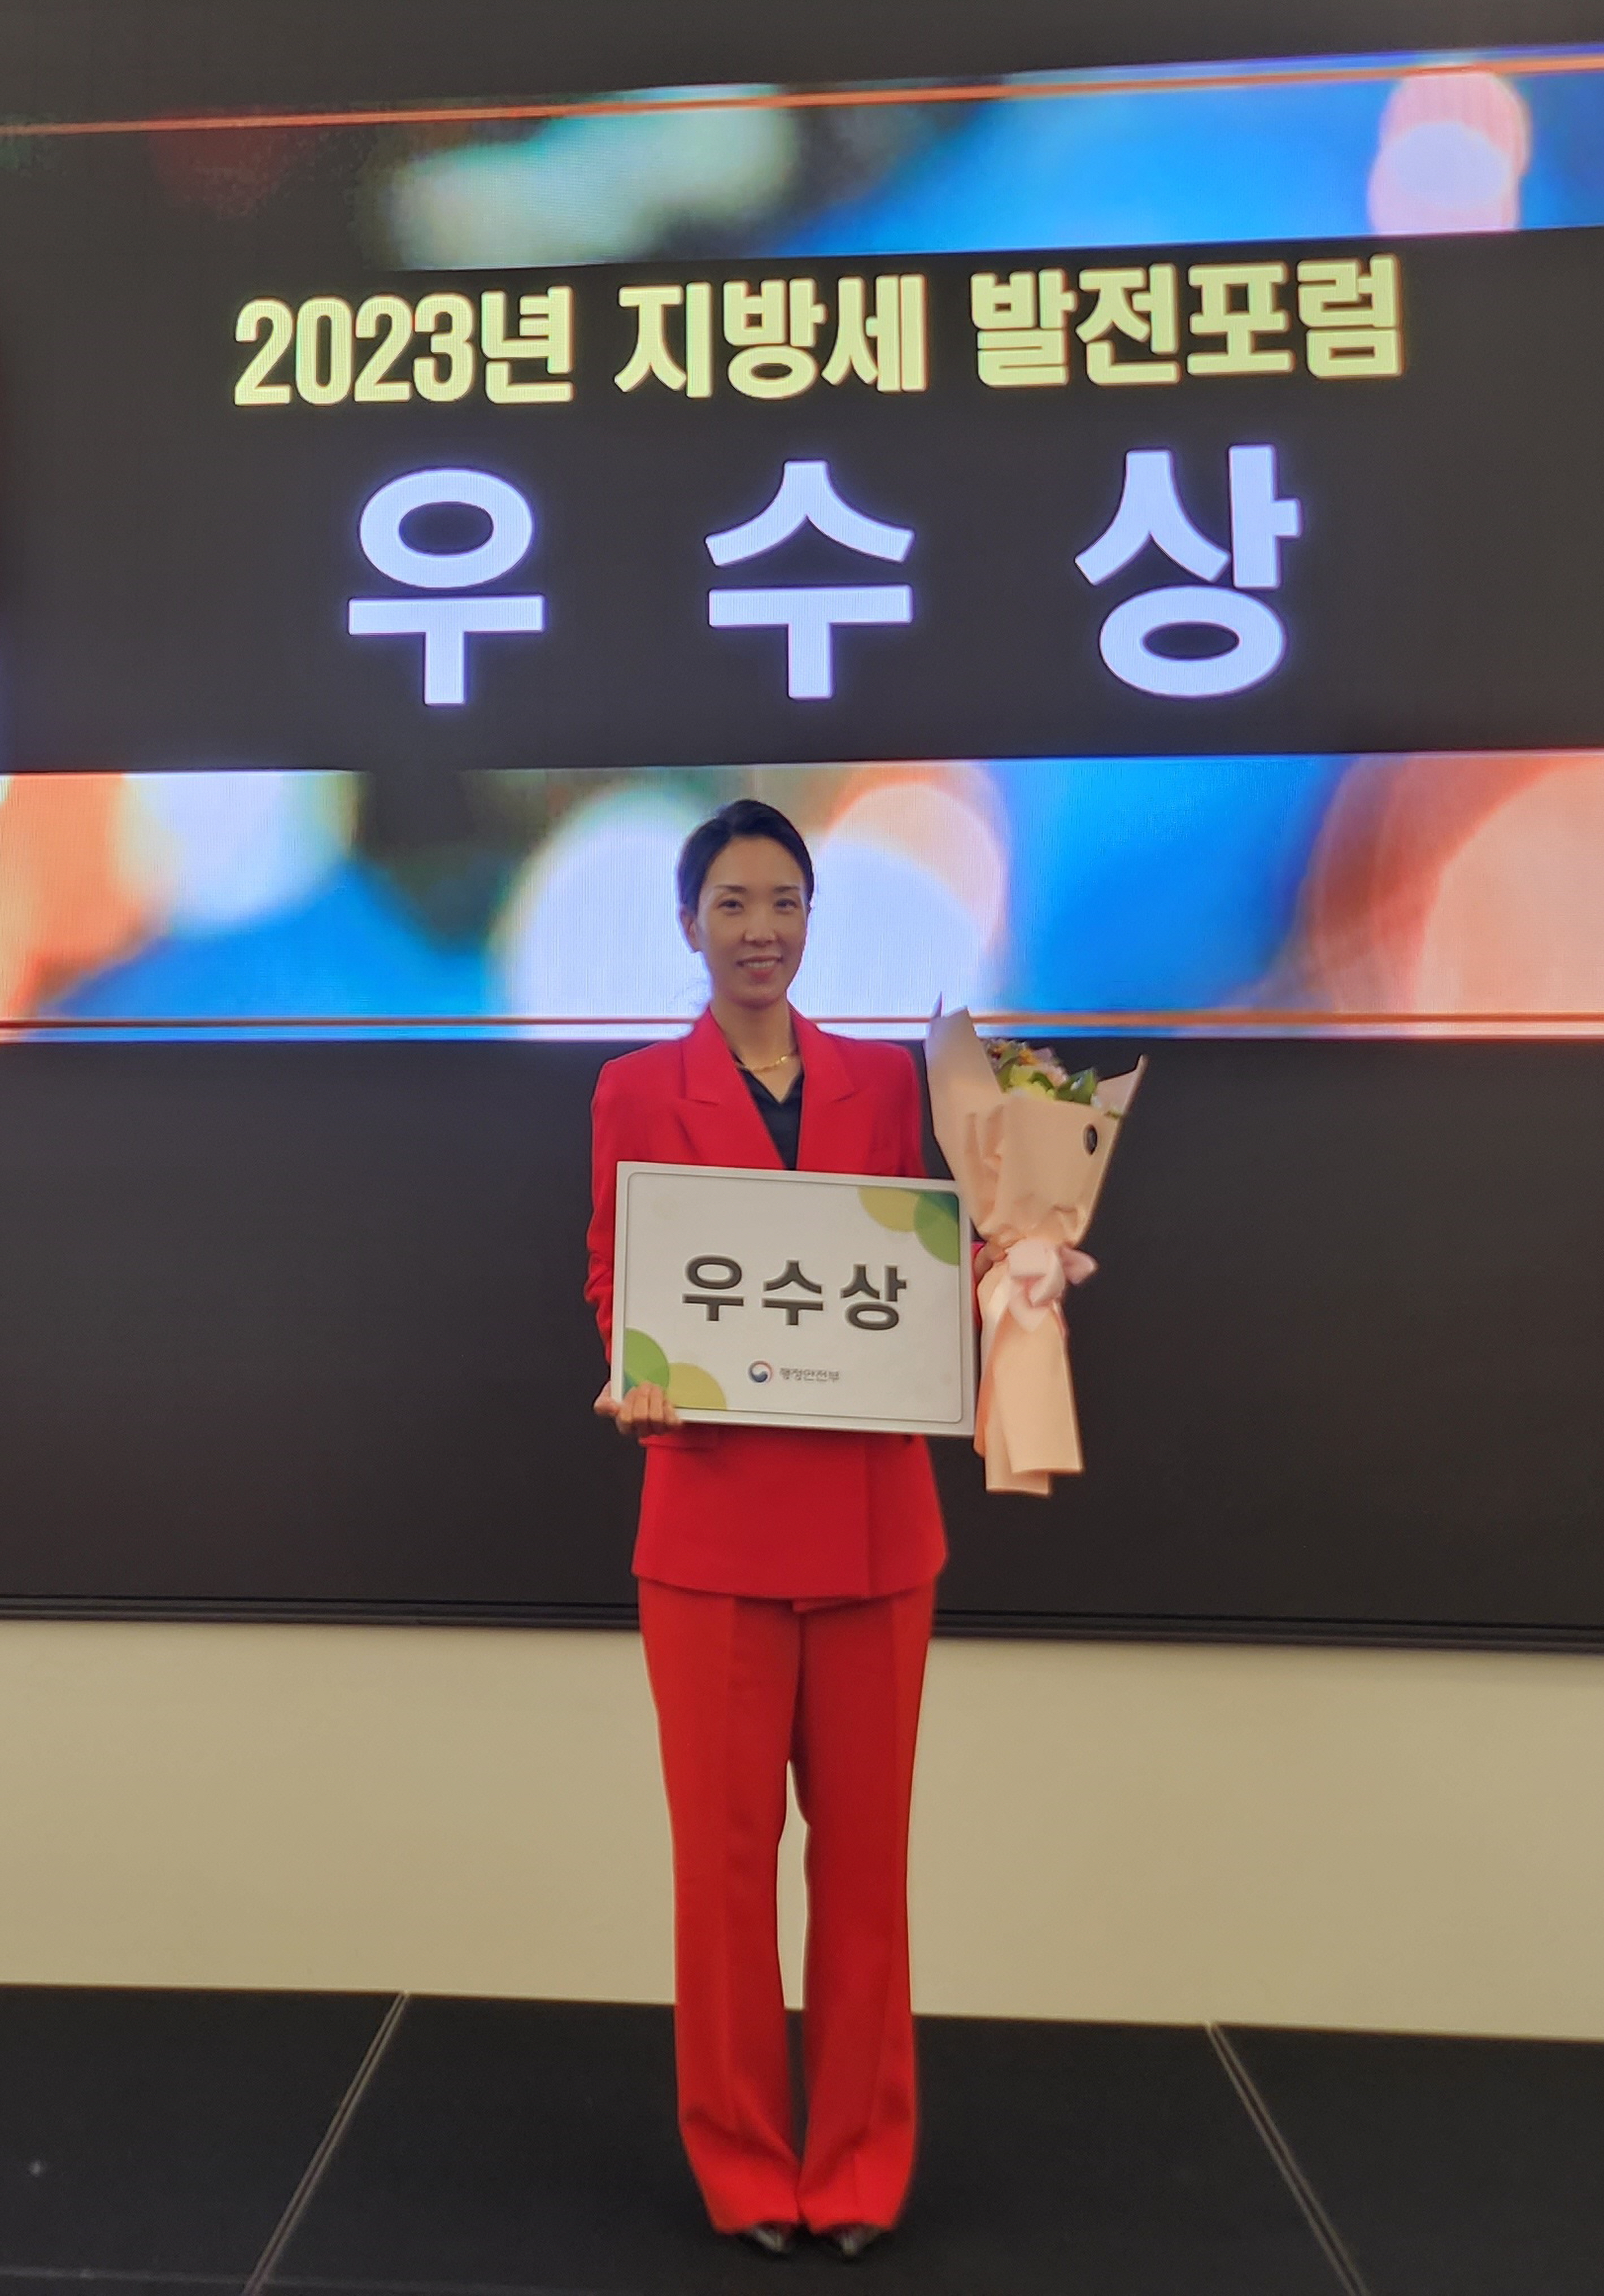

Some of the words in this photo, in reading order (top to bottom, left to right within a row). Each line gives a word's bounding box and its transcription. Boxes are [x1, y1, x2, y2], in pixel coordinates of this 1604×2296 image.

[234, 285, 573, 406] 2023년
[613, 274, 927, 399] 지방세
[970, 254, 1402, 388] 발전포럼
[682, 1253, 908, 1331] 우수상
